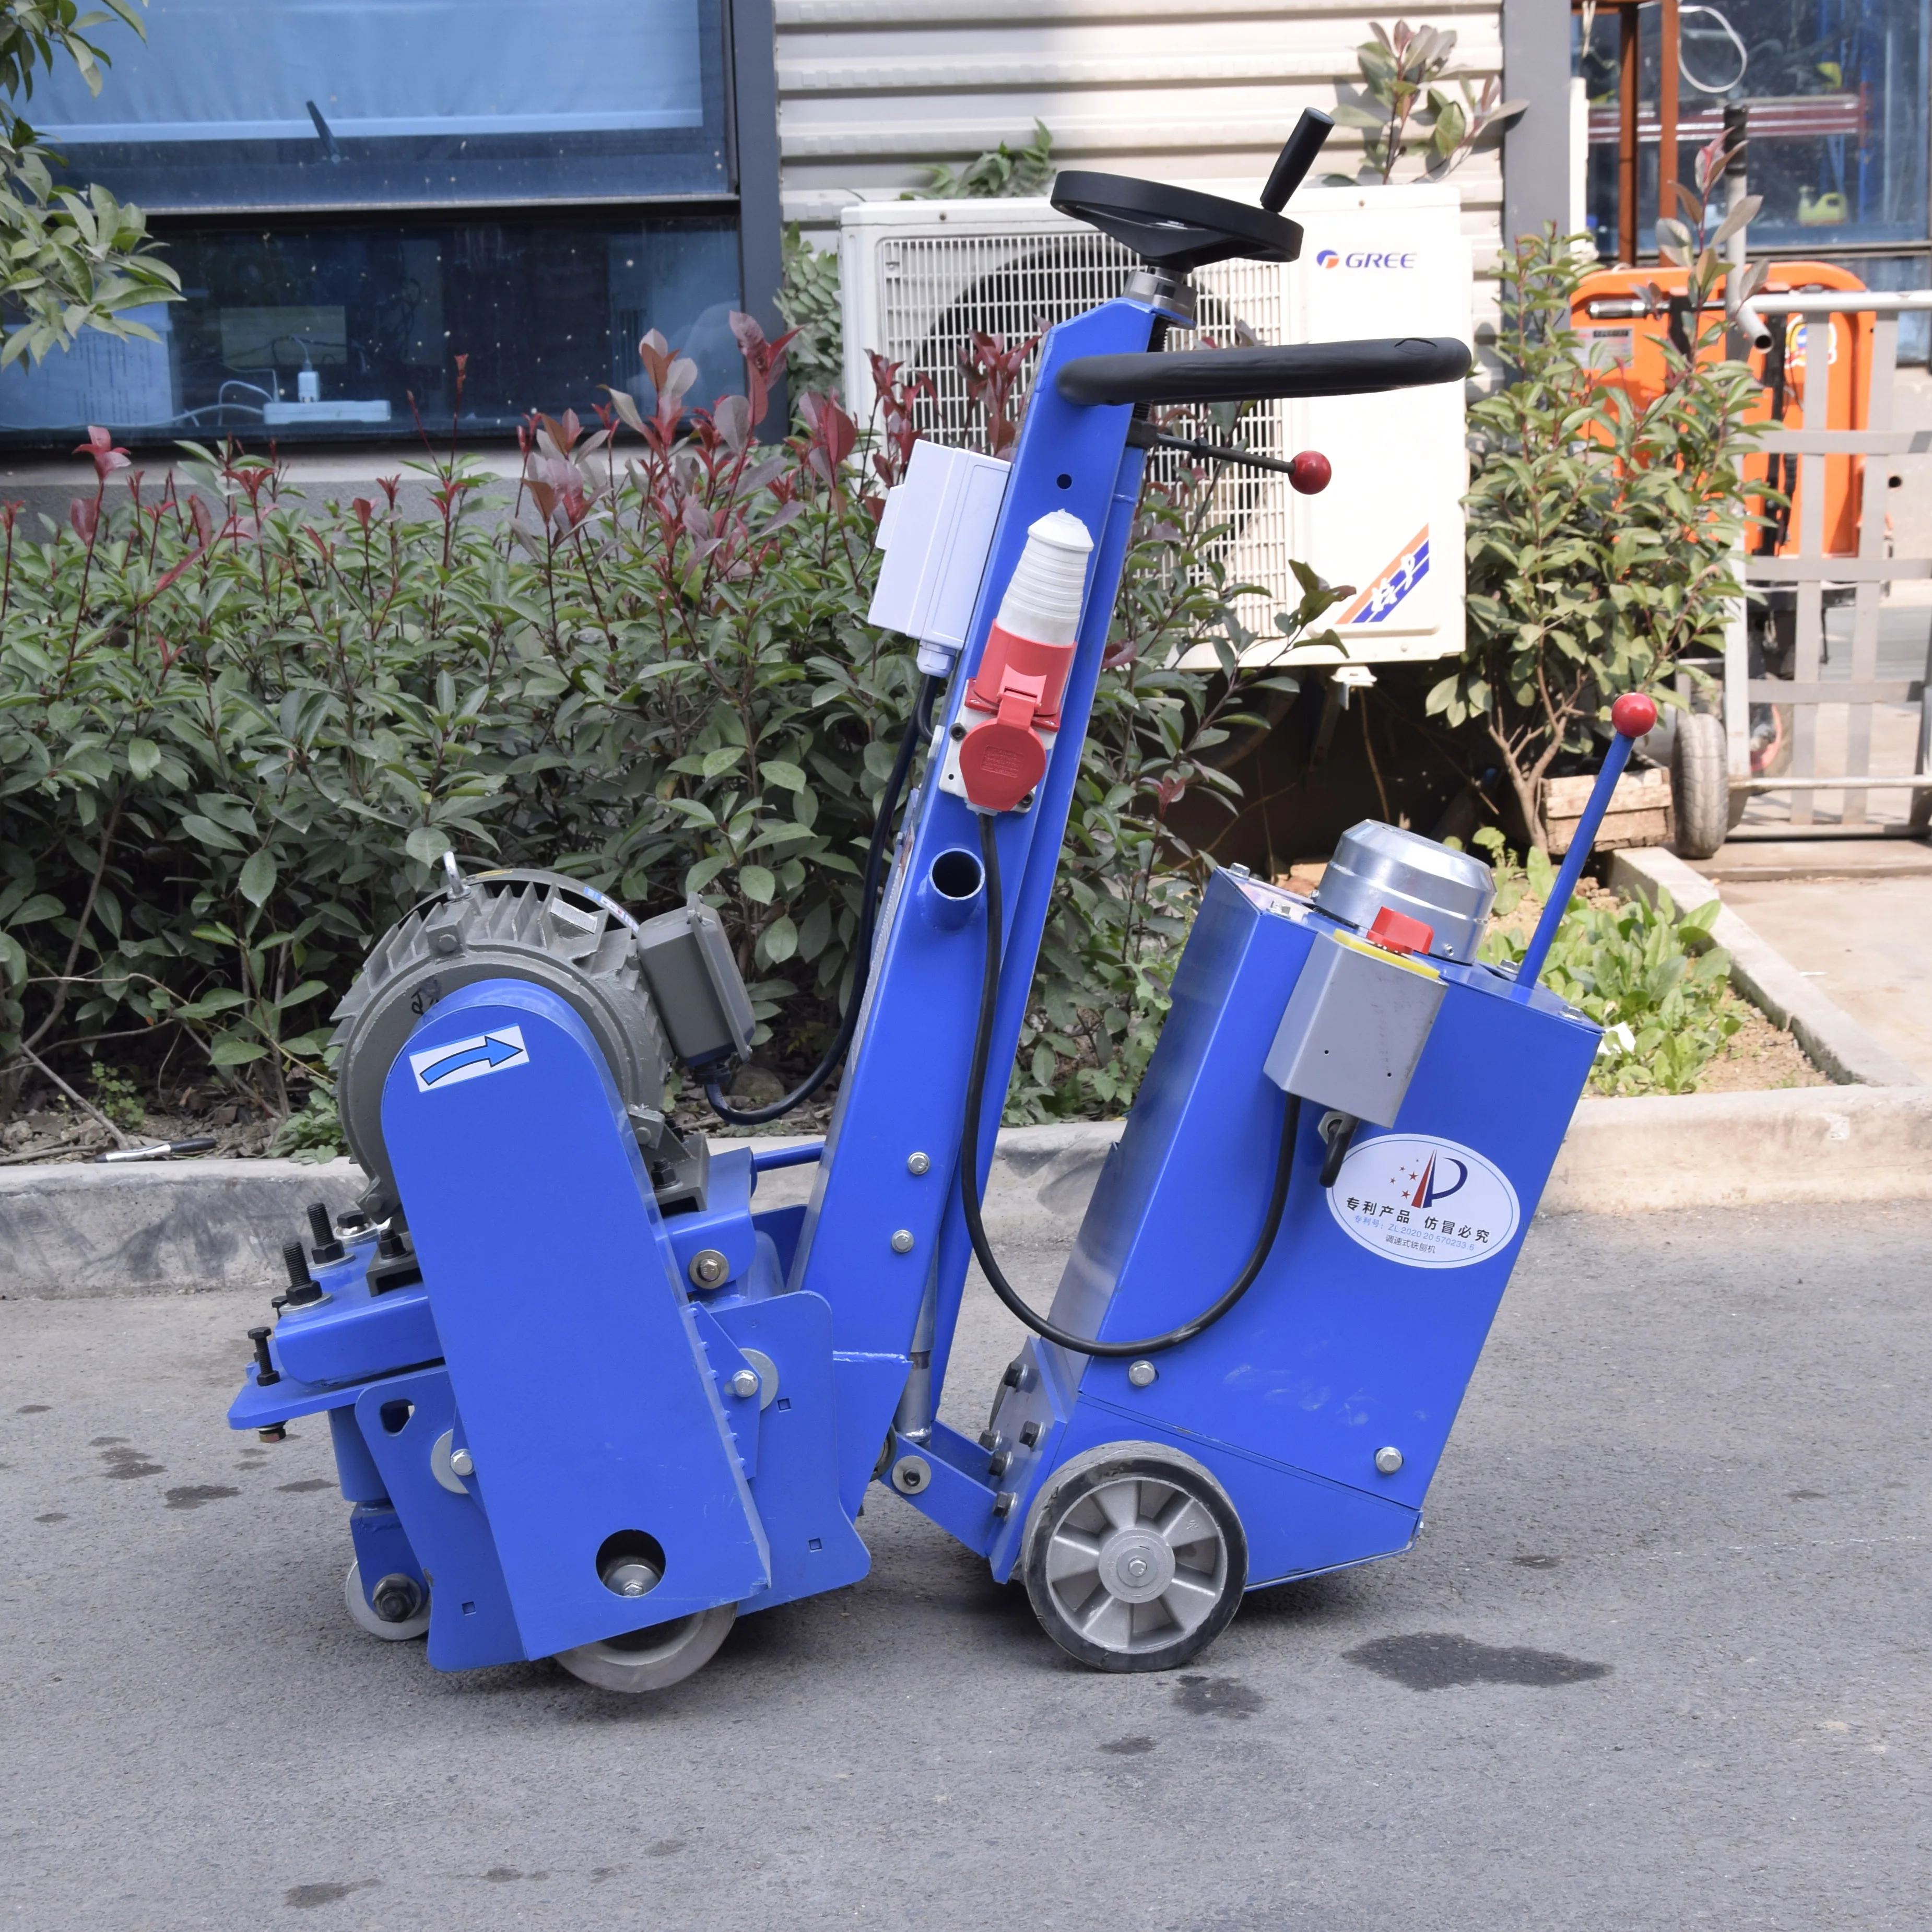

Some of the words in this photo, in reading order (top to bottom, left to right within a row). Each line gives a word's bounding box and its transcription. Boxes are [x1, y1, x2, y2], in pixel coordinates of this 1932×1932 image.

[1346, 253, 1417, 268] GREE
[1346, 1196, 1410, 1224] 专利产品
[1424, 1216, 1490, 1243] 仿冒必究
[1385, 1234, 1436, 1254] 调速式铣刨机
[1388, 1223, 1398, 1232] ZL
[1400, 1227, 1422, 1238] 2020
[1423, 1232, 1434, 1241] 20
[1435, 1235, 1475, 1251] 570233.6
